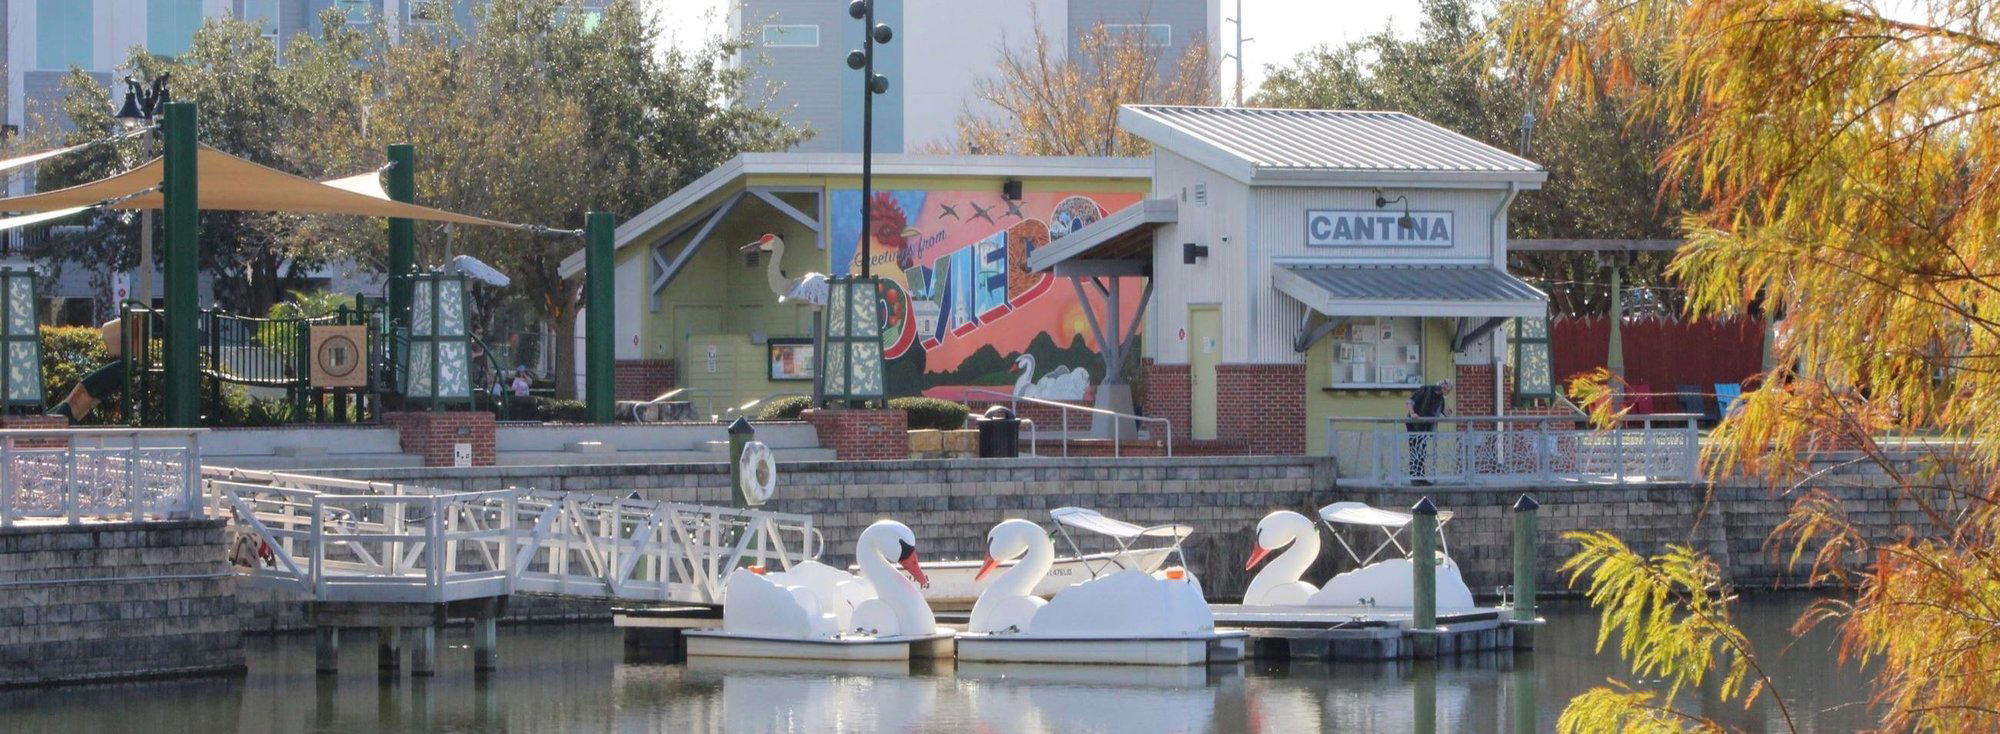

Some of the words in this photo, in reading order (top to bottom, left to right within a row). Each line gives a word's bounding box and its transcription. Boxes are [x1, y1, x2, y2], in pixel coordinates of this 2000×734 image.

[1310, 215, 1450, 241] CANTINA
[854, 246, 915, 268] Geetings
[916, 229, 946, 260] from
